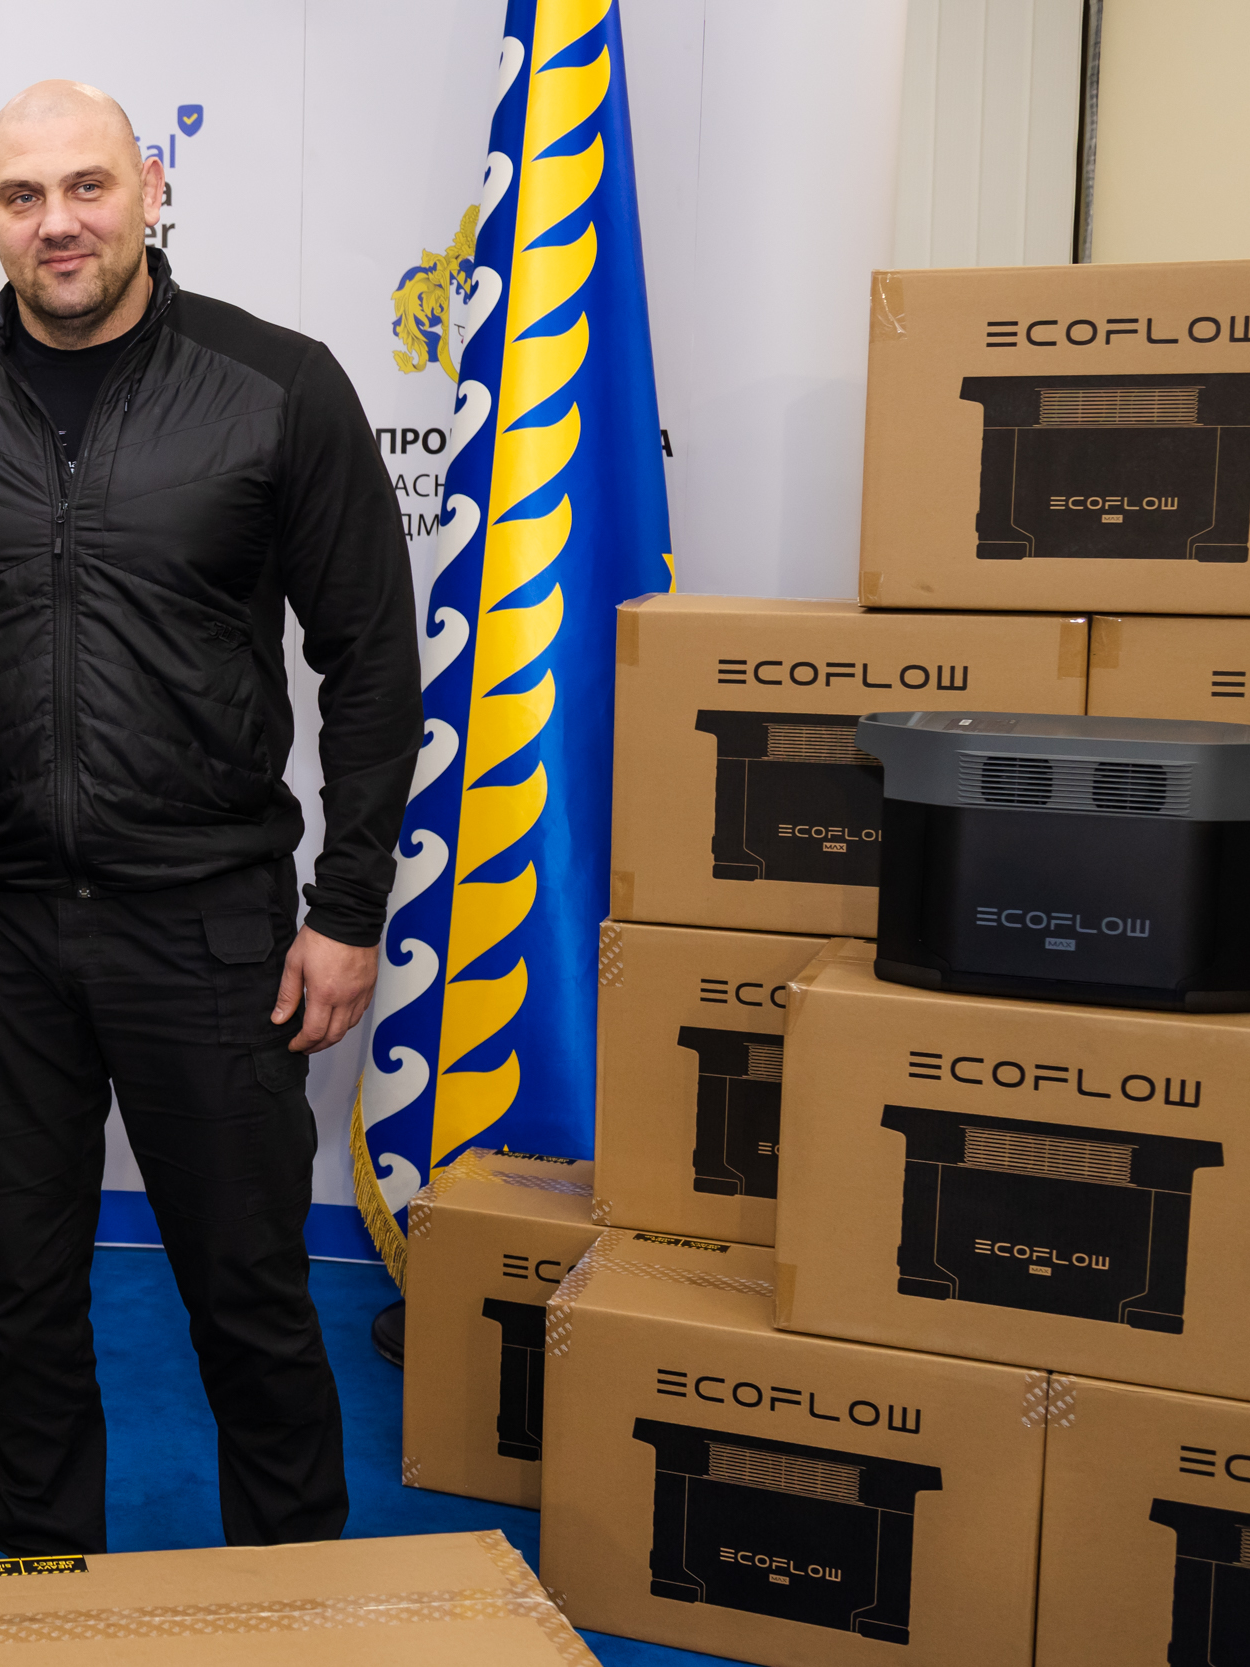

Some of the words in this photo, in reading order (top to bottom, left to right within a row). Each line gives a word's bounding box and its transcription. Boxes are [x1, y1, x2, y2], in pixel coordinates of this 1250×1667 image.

[985, 315, 1250, 347] ECOFLOW
[1049, 496, 1178, 510] ECOFLOW
[717, 658, 969, 692] ECOFLOW
[824, 843, 845, 851] MAX
[976, 906, 1151, 938] ECOFLOW
[1047, 940, 1073, 949] MAX
[908, 1050, 1202, 1109] ECOFLOW
[974, 1239, 1109, 1270] ECOFLOW
[656, 1368, 922, 1436] ECOFLOW
[719, 1546, 842, 1582] ECOFLOW
